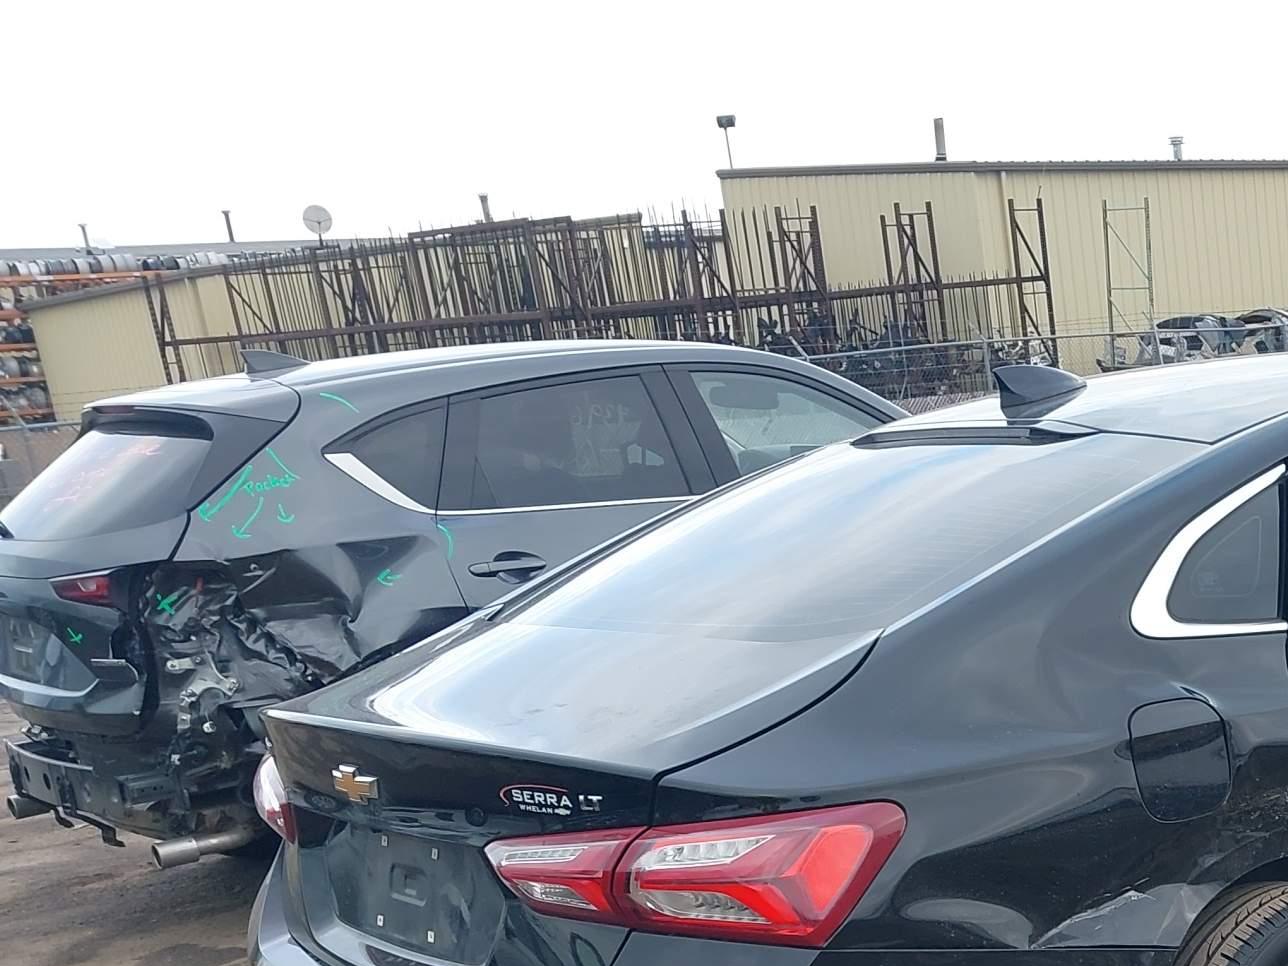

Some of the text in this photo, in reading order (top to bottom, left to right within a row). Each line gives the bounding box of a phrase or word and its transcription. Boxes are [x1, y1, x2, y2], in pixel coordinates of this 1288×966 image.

[511, 789, 572, 807] SERRA
[578, 795, 603, 811] LT
[519, 803, 554, 814] WHELAN
